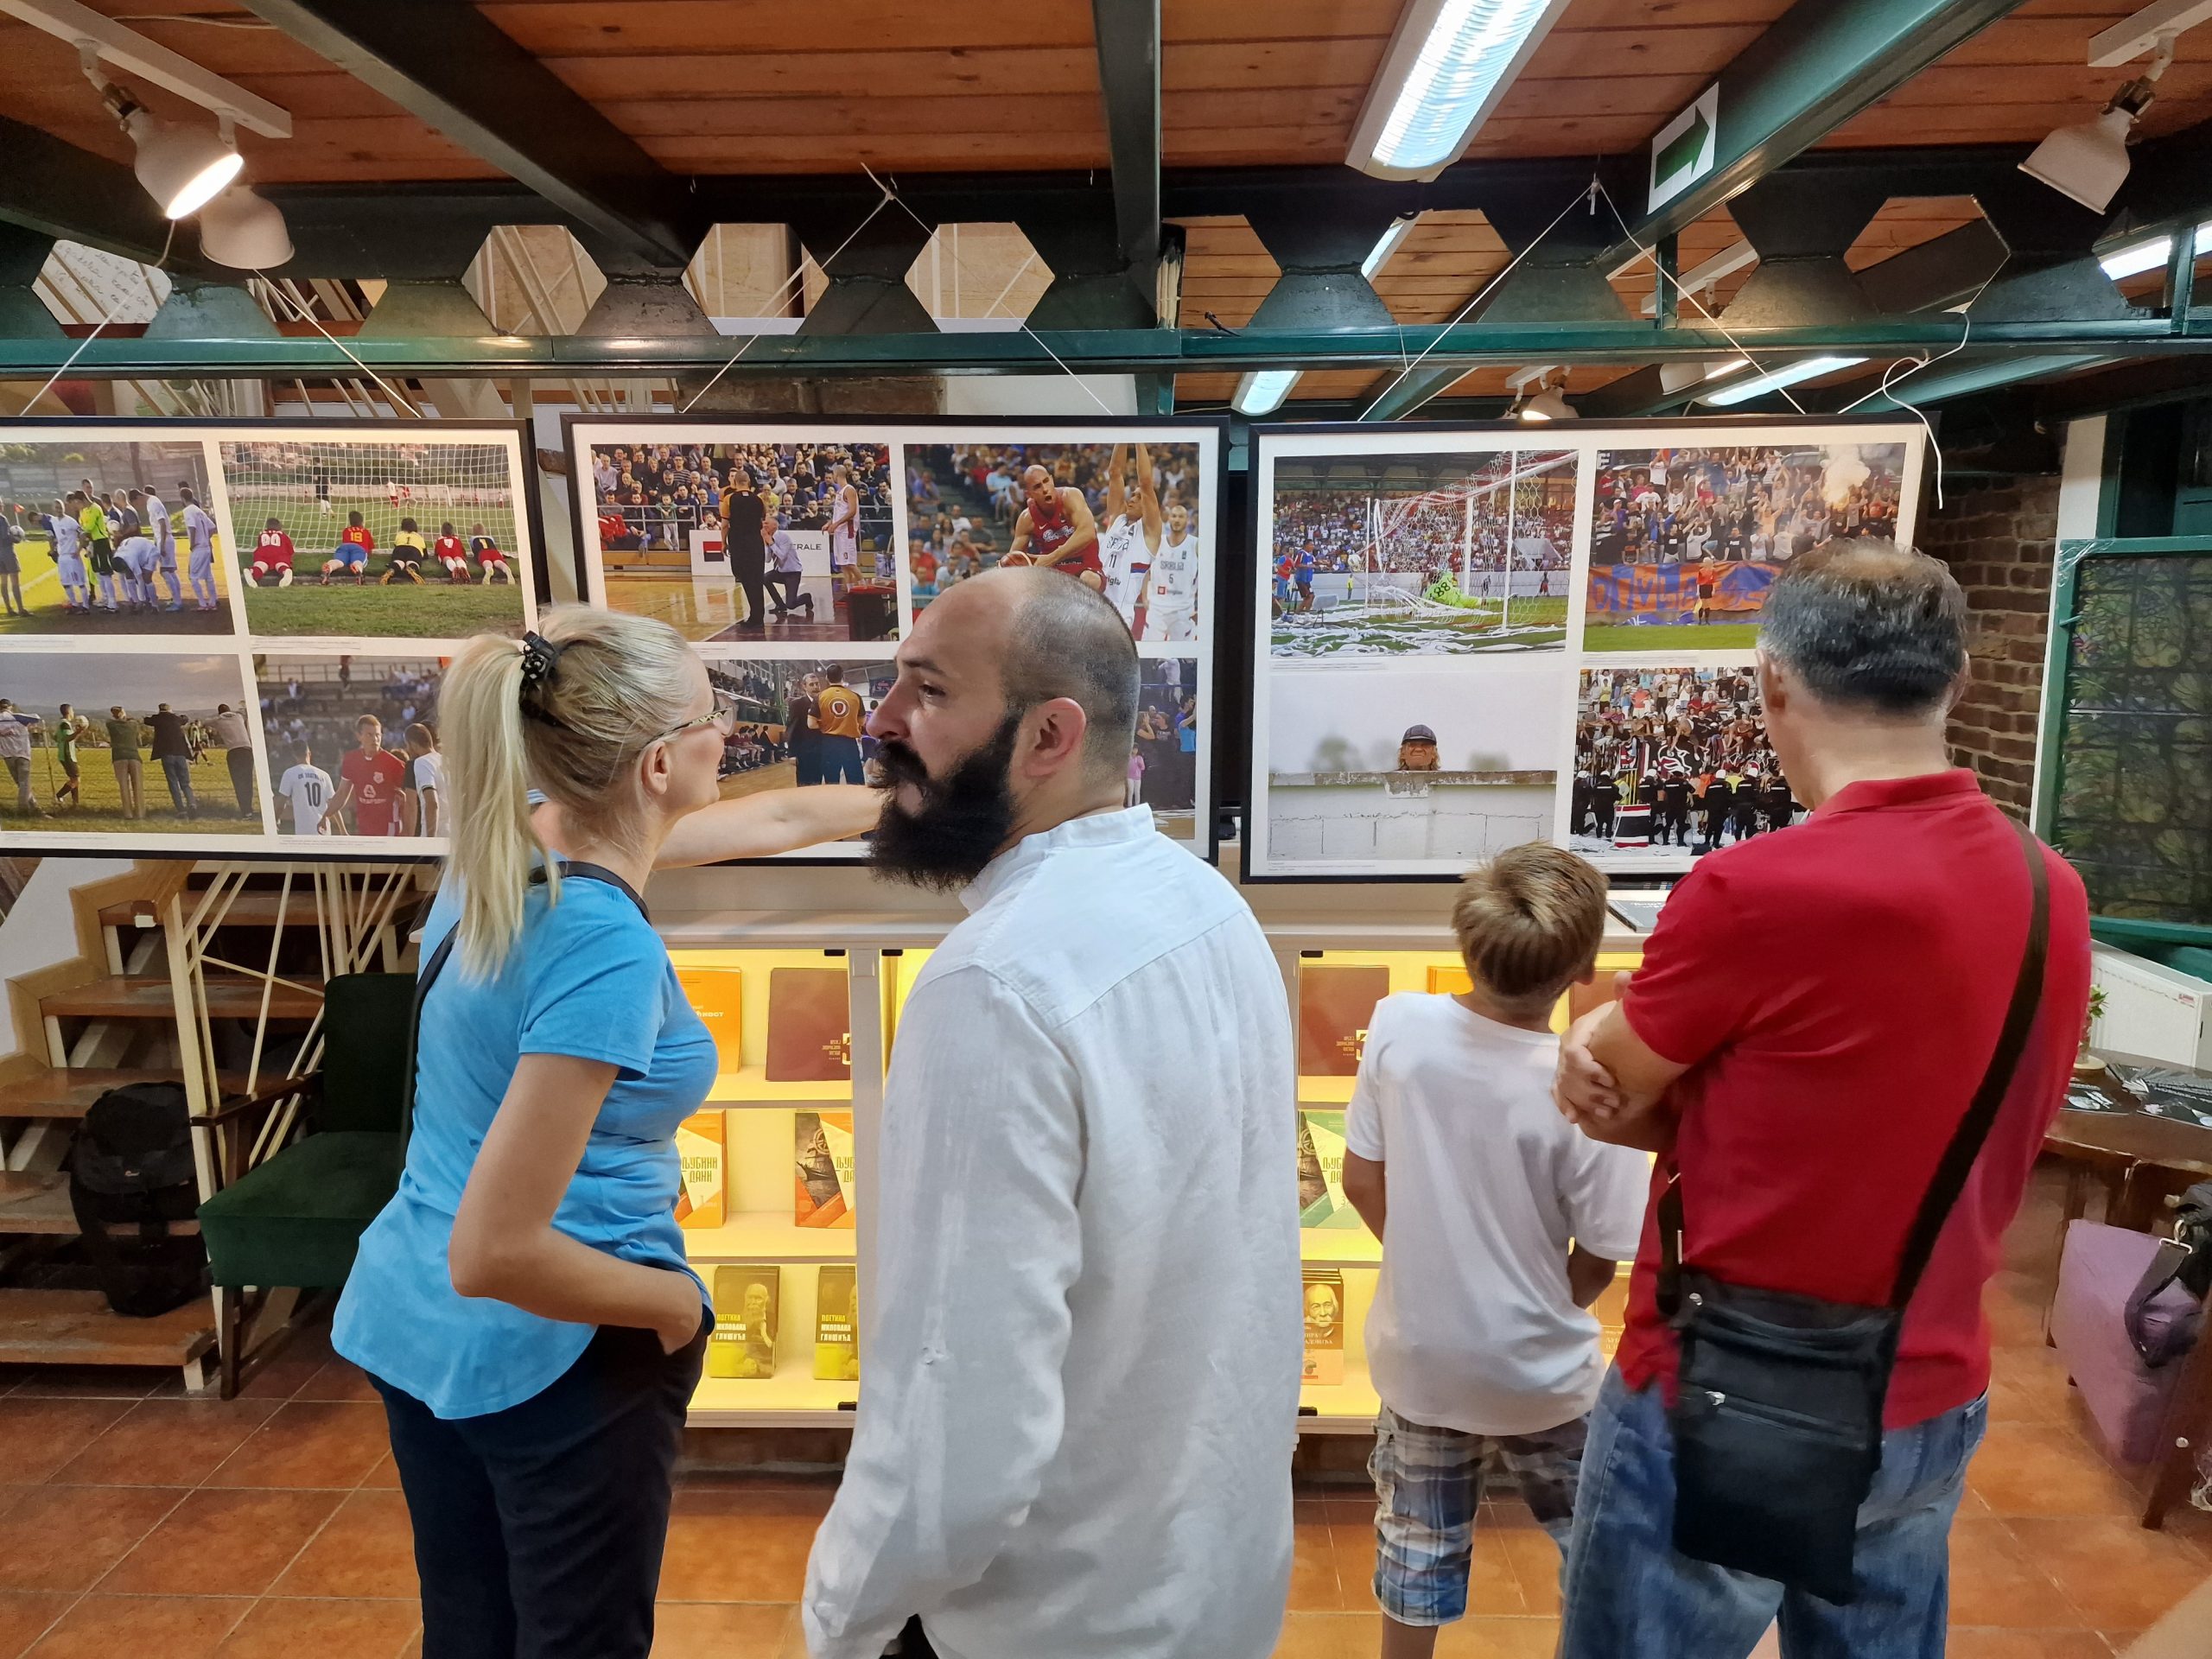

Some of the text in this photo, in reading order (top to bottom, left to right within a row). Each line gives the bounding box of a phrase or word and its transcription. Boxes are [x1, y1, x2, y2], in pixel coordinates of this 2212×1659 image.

[1433, 582, 1451, 597] 88
[304, 782, 321, 807] 10
[1323, 1157, 1342, 1170] ЉУБ
